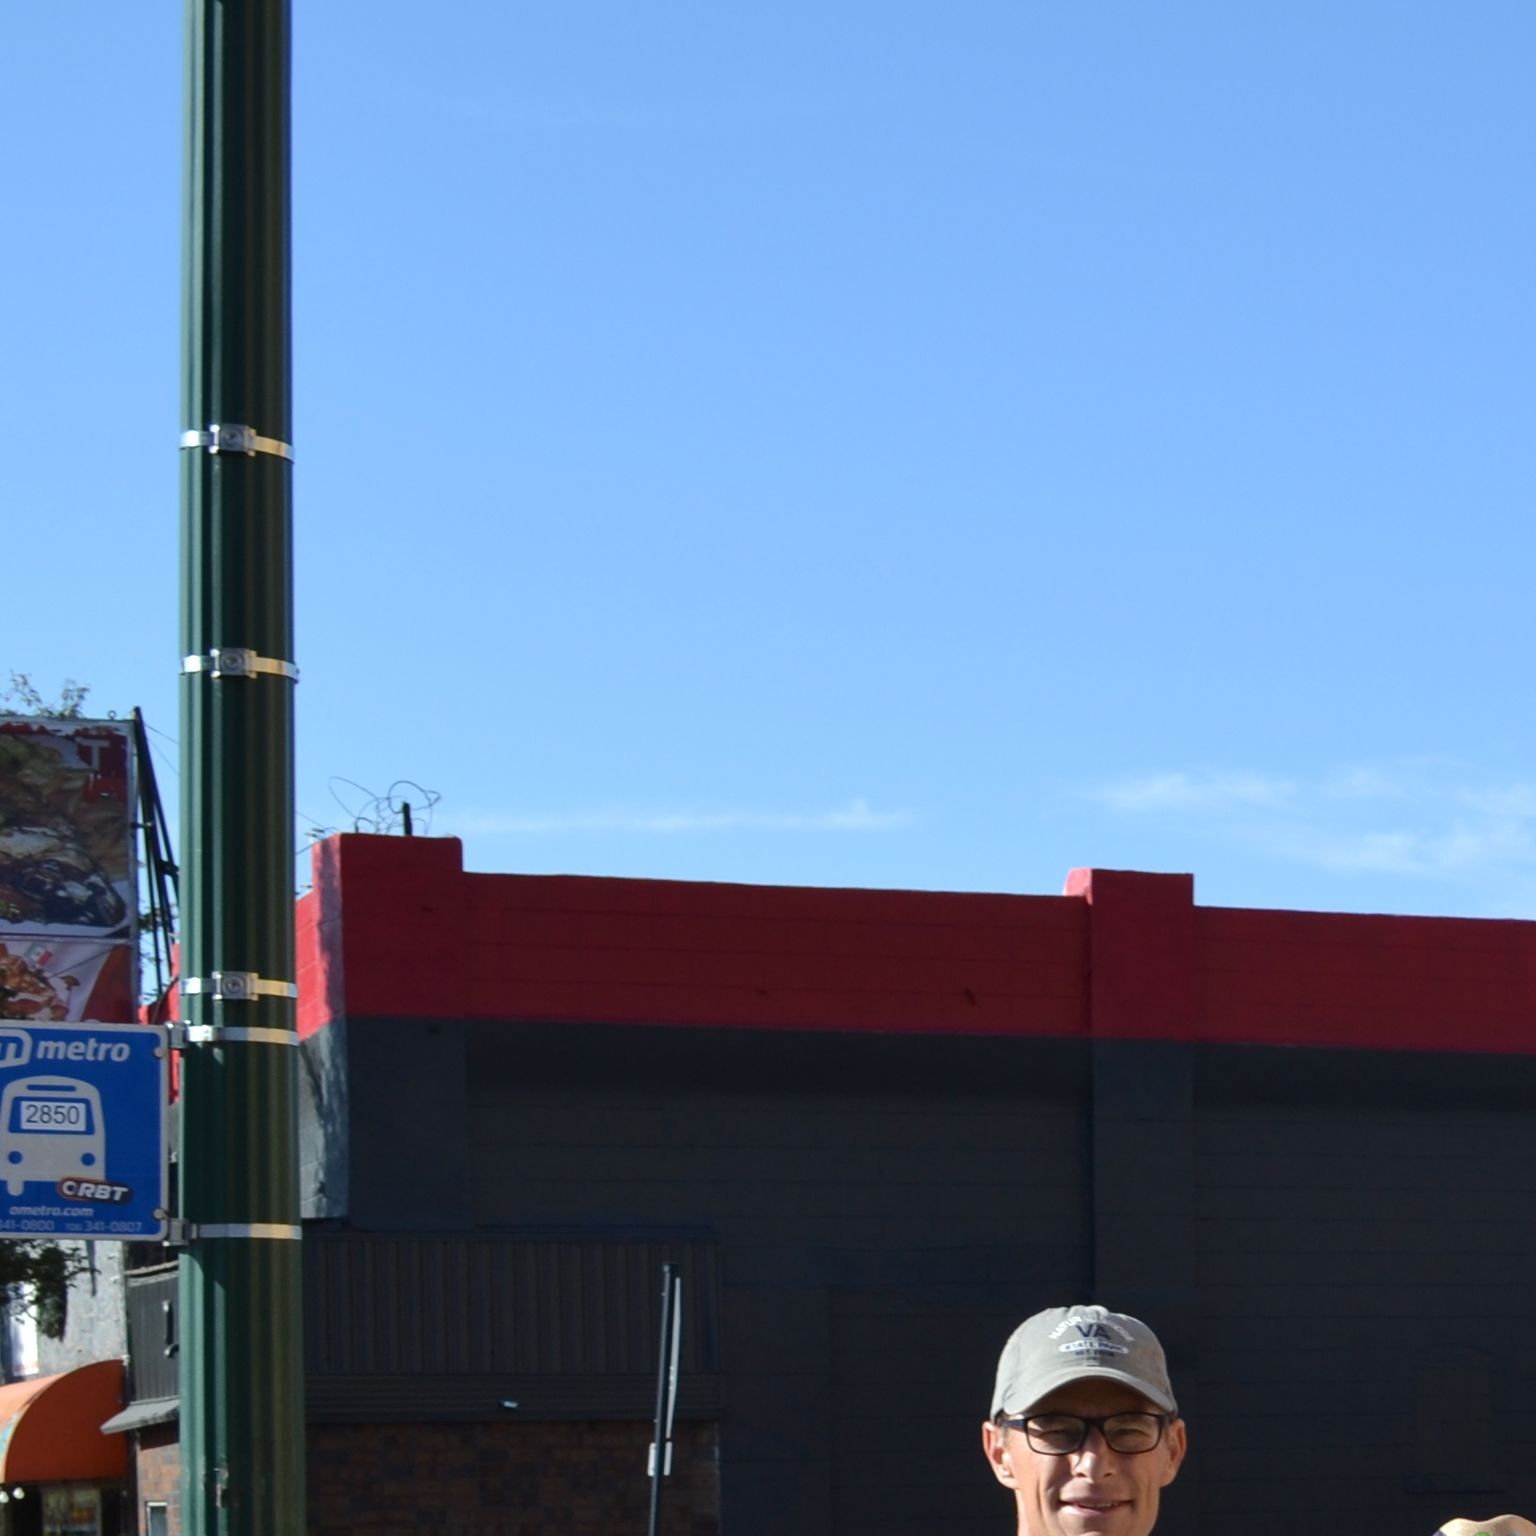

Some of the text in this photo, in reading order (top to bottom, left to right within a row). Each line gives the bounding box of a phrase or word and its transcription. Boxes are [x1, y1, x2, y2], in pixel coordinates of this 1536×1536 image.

[37, 1038, 130, 1062] metro
[26, 1104, 80, 1125] 2850
[9, 1205, 94, 1217] ometro.com
[1075, 1322, 1111, 1340] VA
